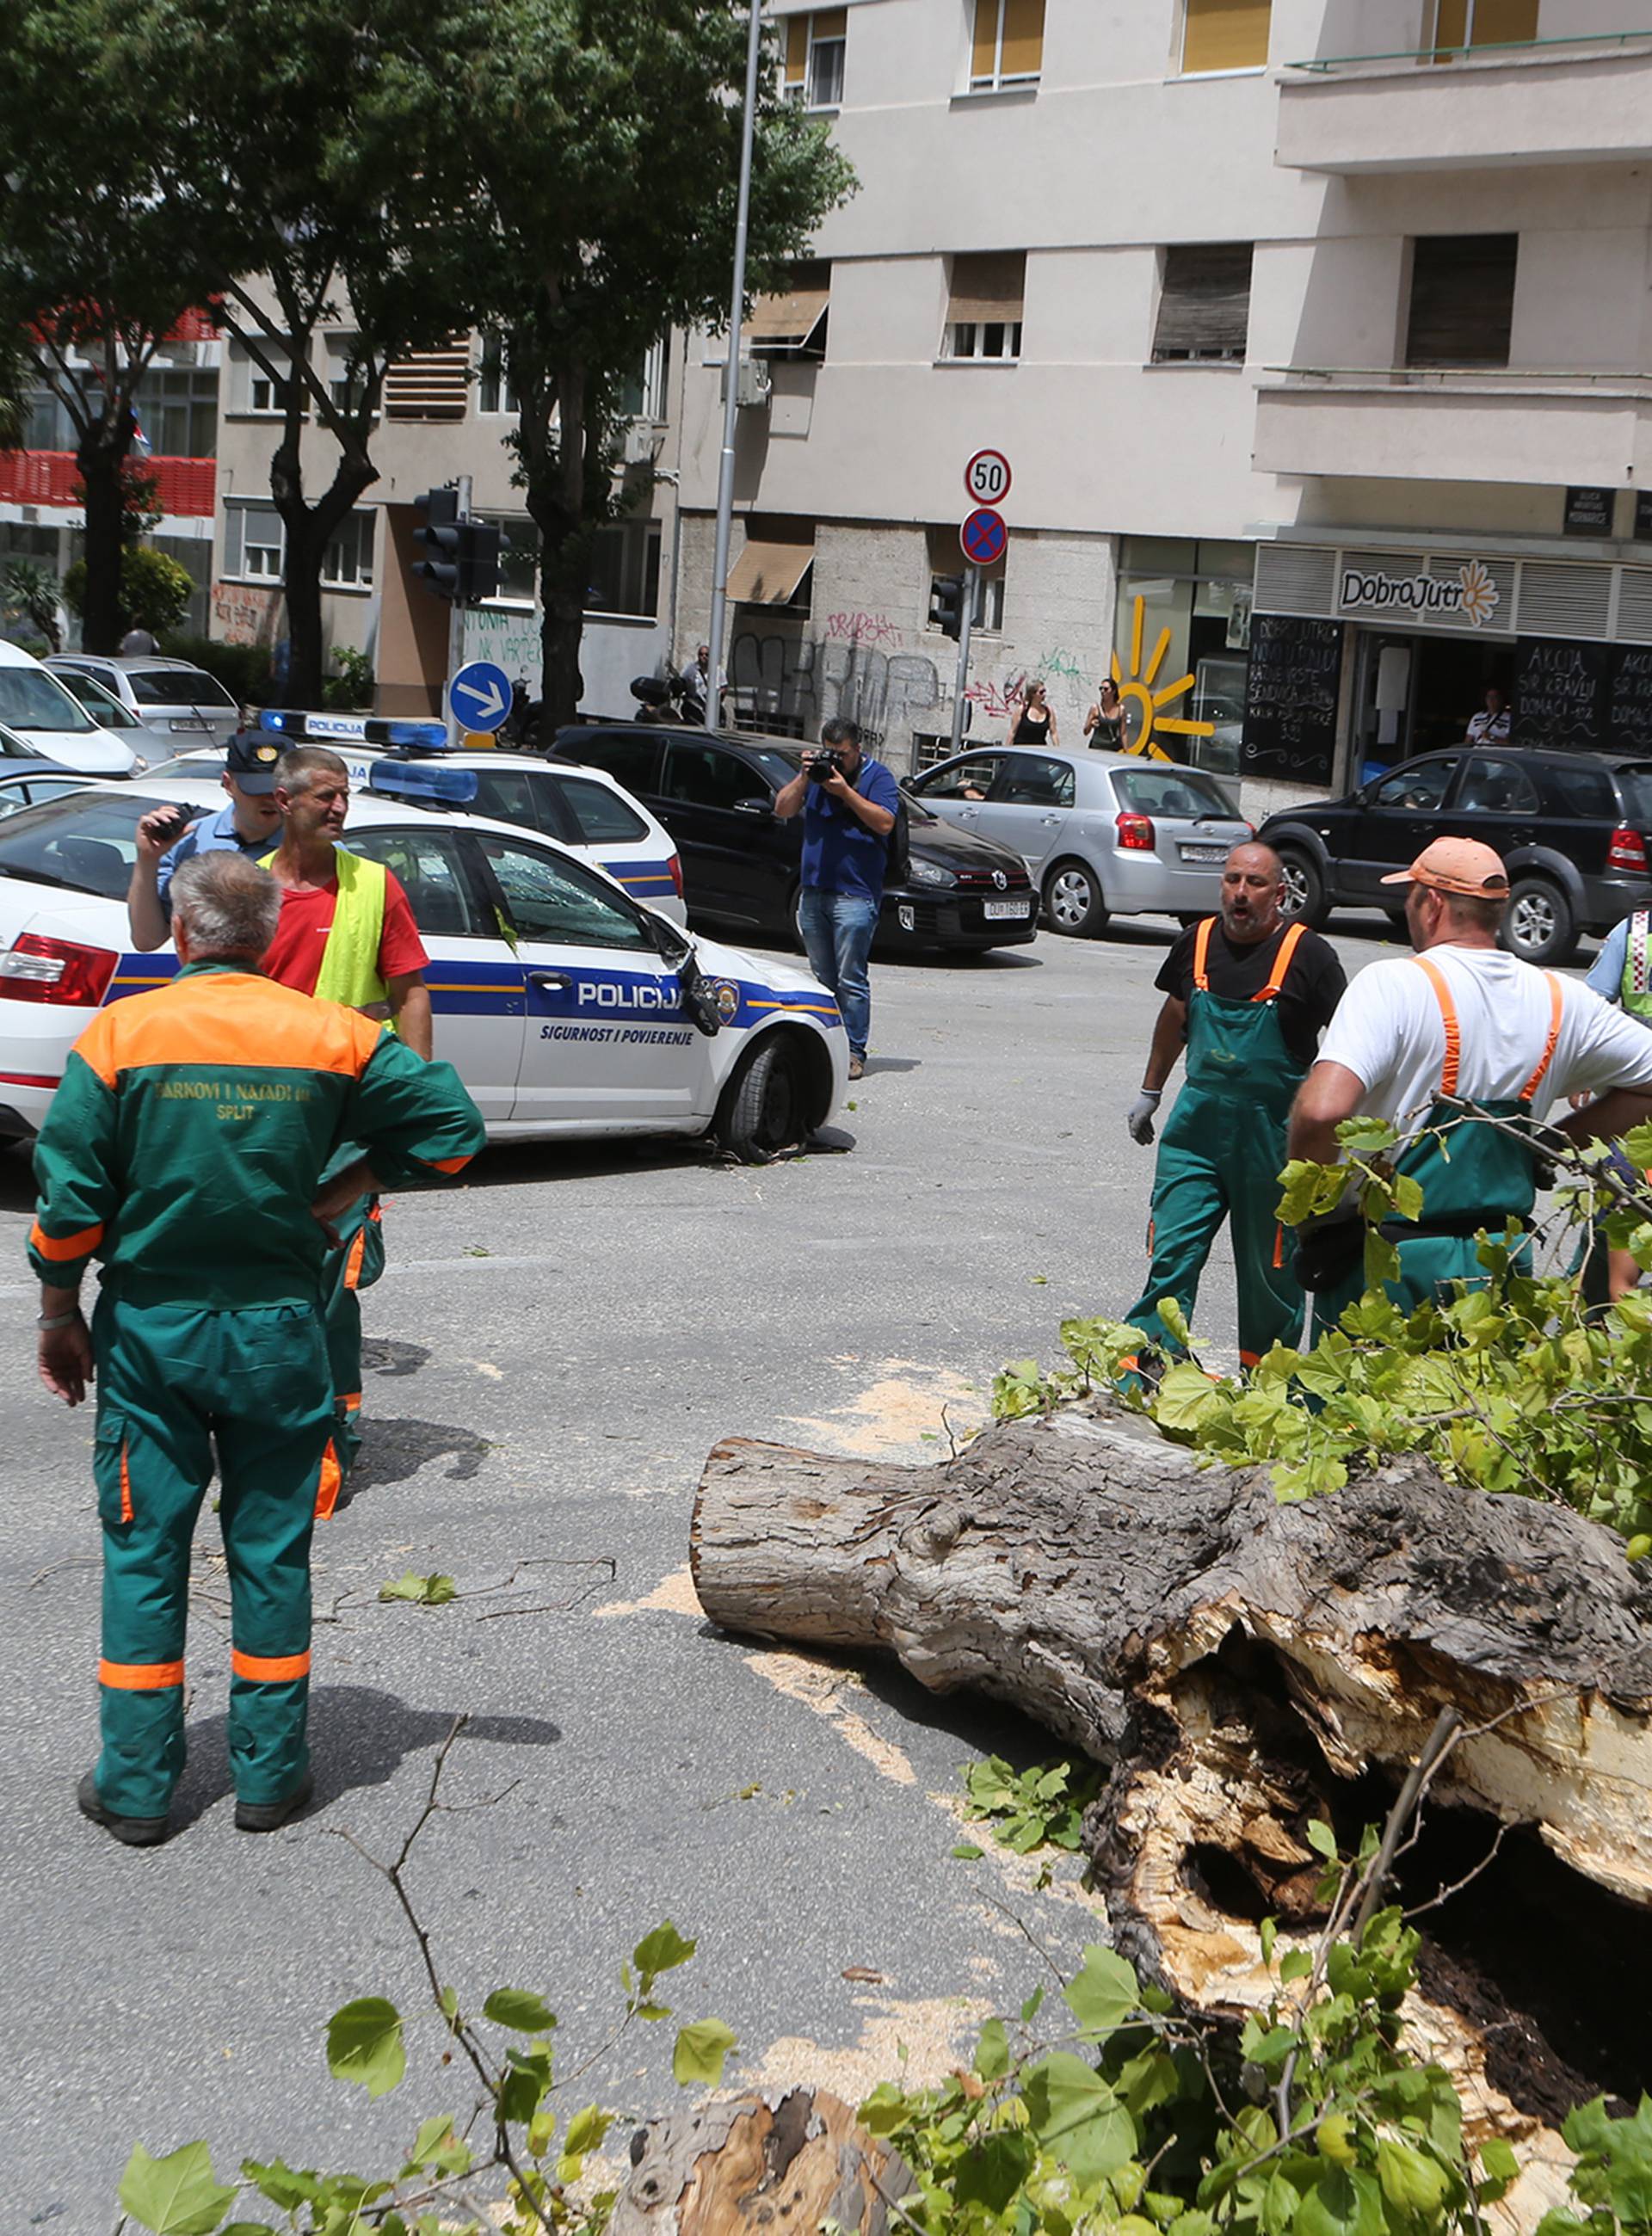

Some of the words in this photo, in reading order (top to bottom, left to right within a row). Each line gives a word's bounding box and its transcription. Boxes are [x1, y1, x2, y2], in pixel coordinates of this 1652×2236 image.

[974, 463, 1002, 492] 50
[1527, 647, 1587, 678] AKCIJA
[309, 720, 363, 735] POLICIJA
[540, 1025, 613, 1043] SIGURNOST
[613, 1029, 620, 1043] I
[621, 1030, 693, 1046] POVJERENJE
[225, 1083, 230, 1100] I
[216, 1104, 255, 1120] SPLIT
